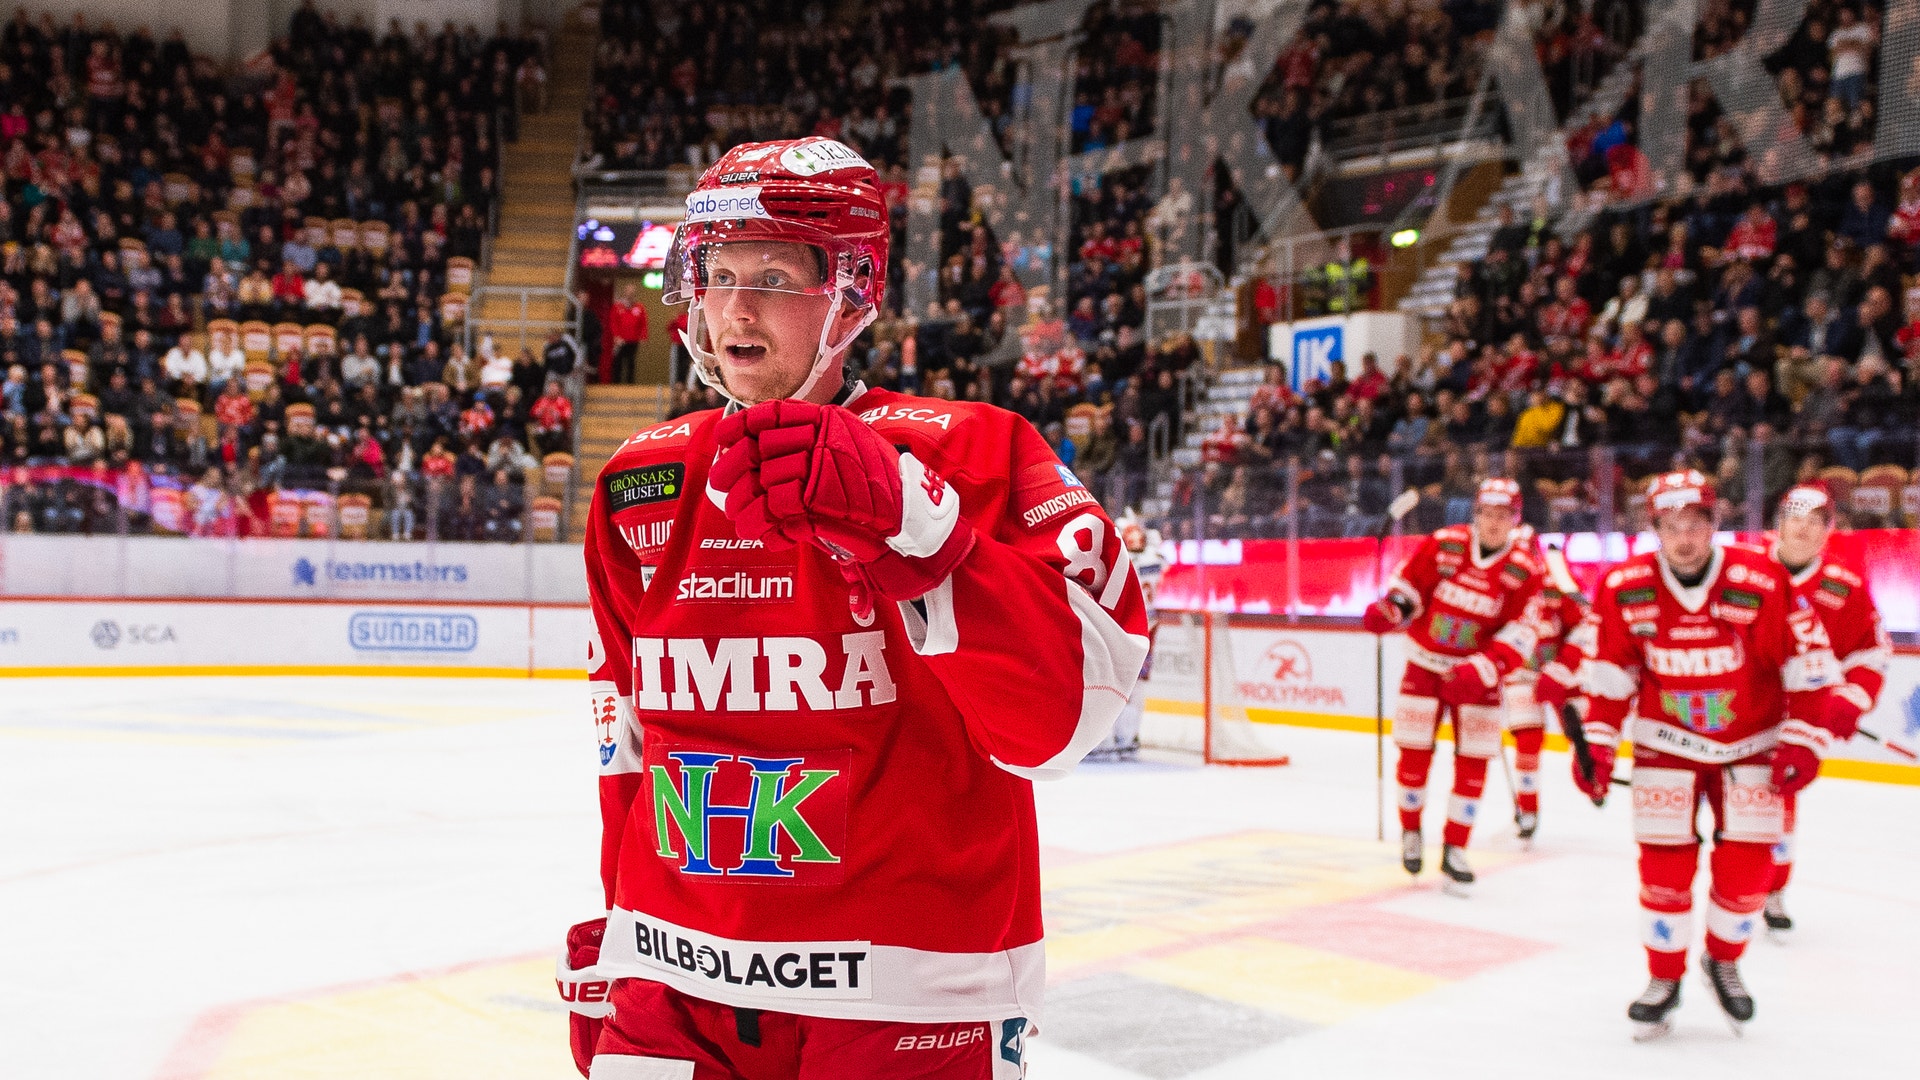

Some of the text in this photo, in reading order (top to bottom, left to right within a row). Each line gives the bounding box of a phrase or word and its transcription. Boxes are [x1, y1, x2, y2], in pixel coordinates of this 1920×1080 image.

[886, 407, 953, 430] SCA
[630, 423, 691, 445] SCA
[609, 469, 676, 494] GRÖNSAKS
[623, 483, 665, 502] HUSET
[700, 538, 765, 549] BAUER
[324, 560, 468, 582] teamsters
[676, 571, 793, 600] stadium
[126, 624, 178, 645] SCA
[632, 606, 898, 713] IMRÅ
[649, 751, 841, 879] NHK
[634, 921, 867, 990] BILBOLAGET
[894, 1026, 985, 1052] BAUER
